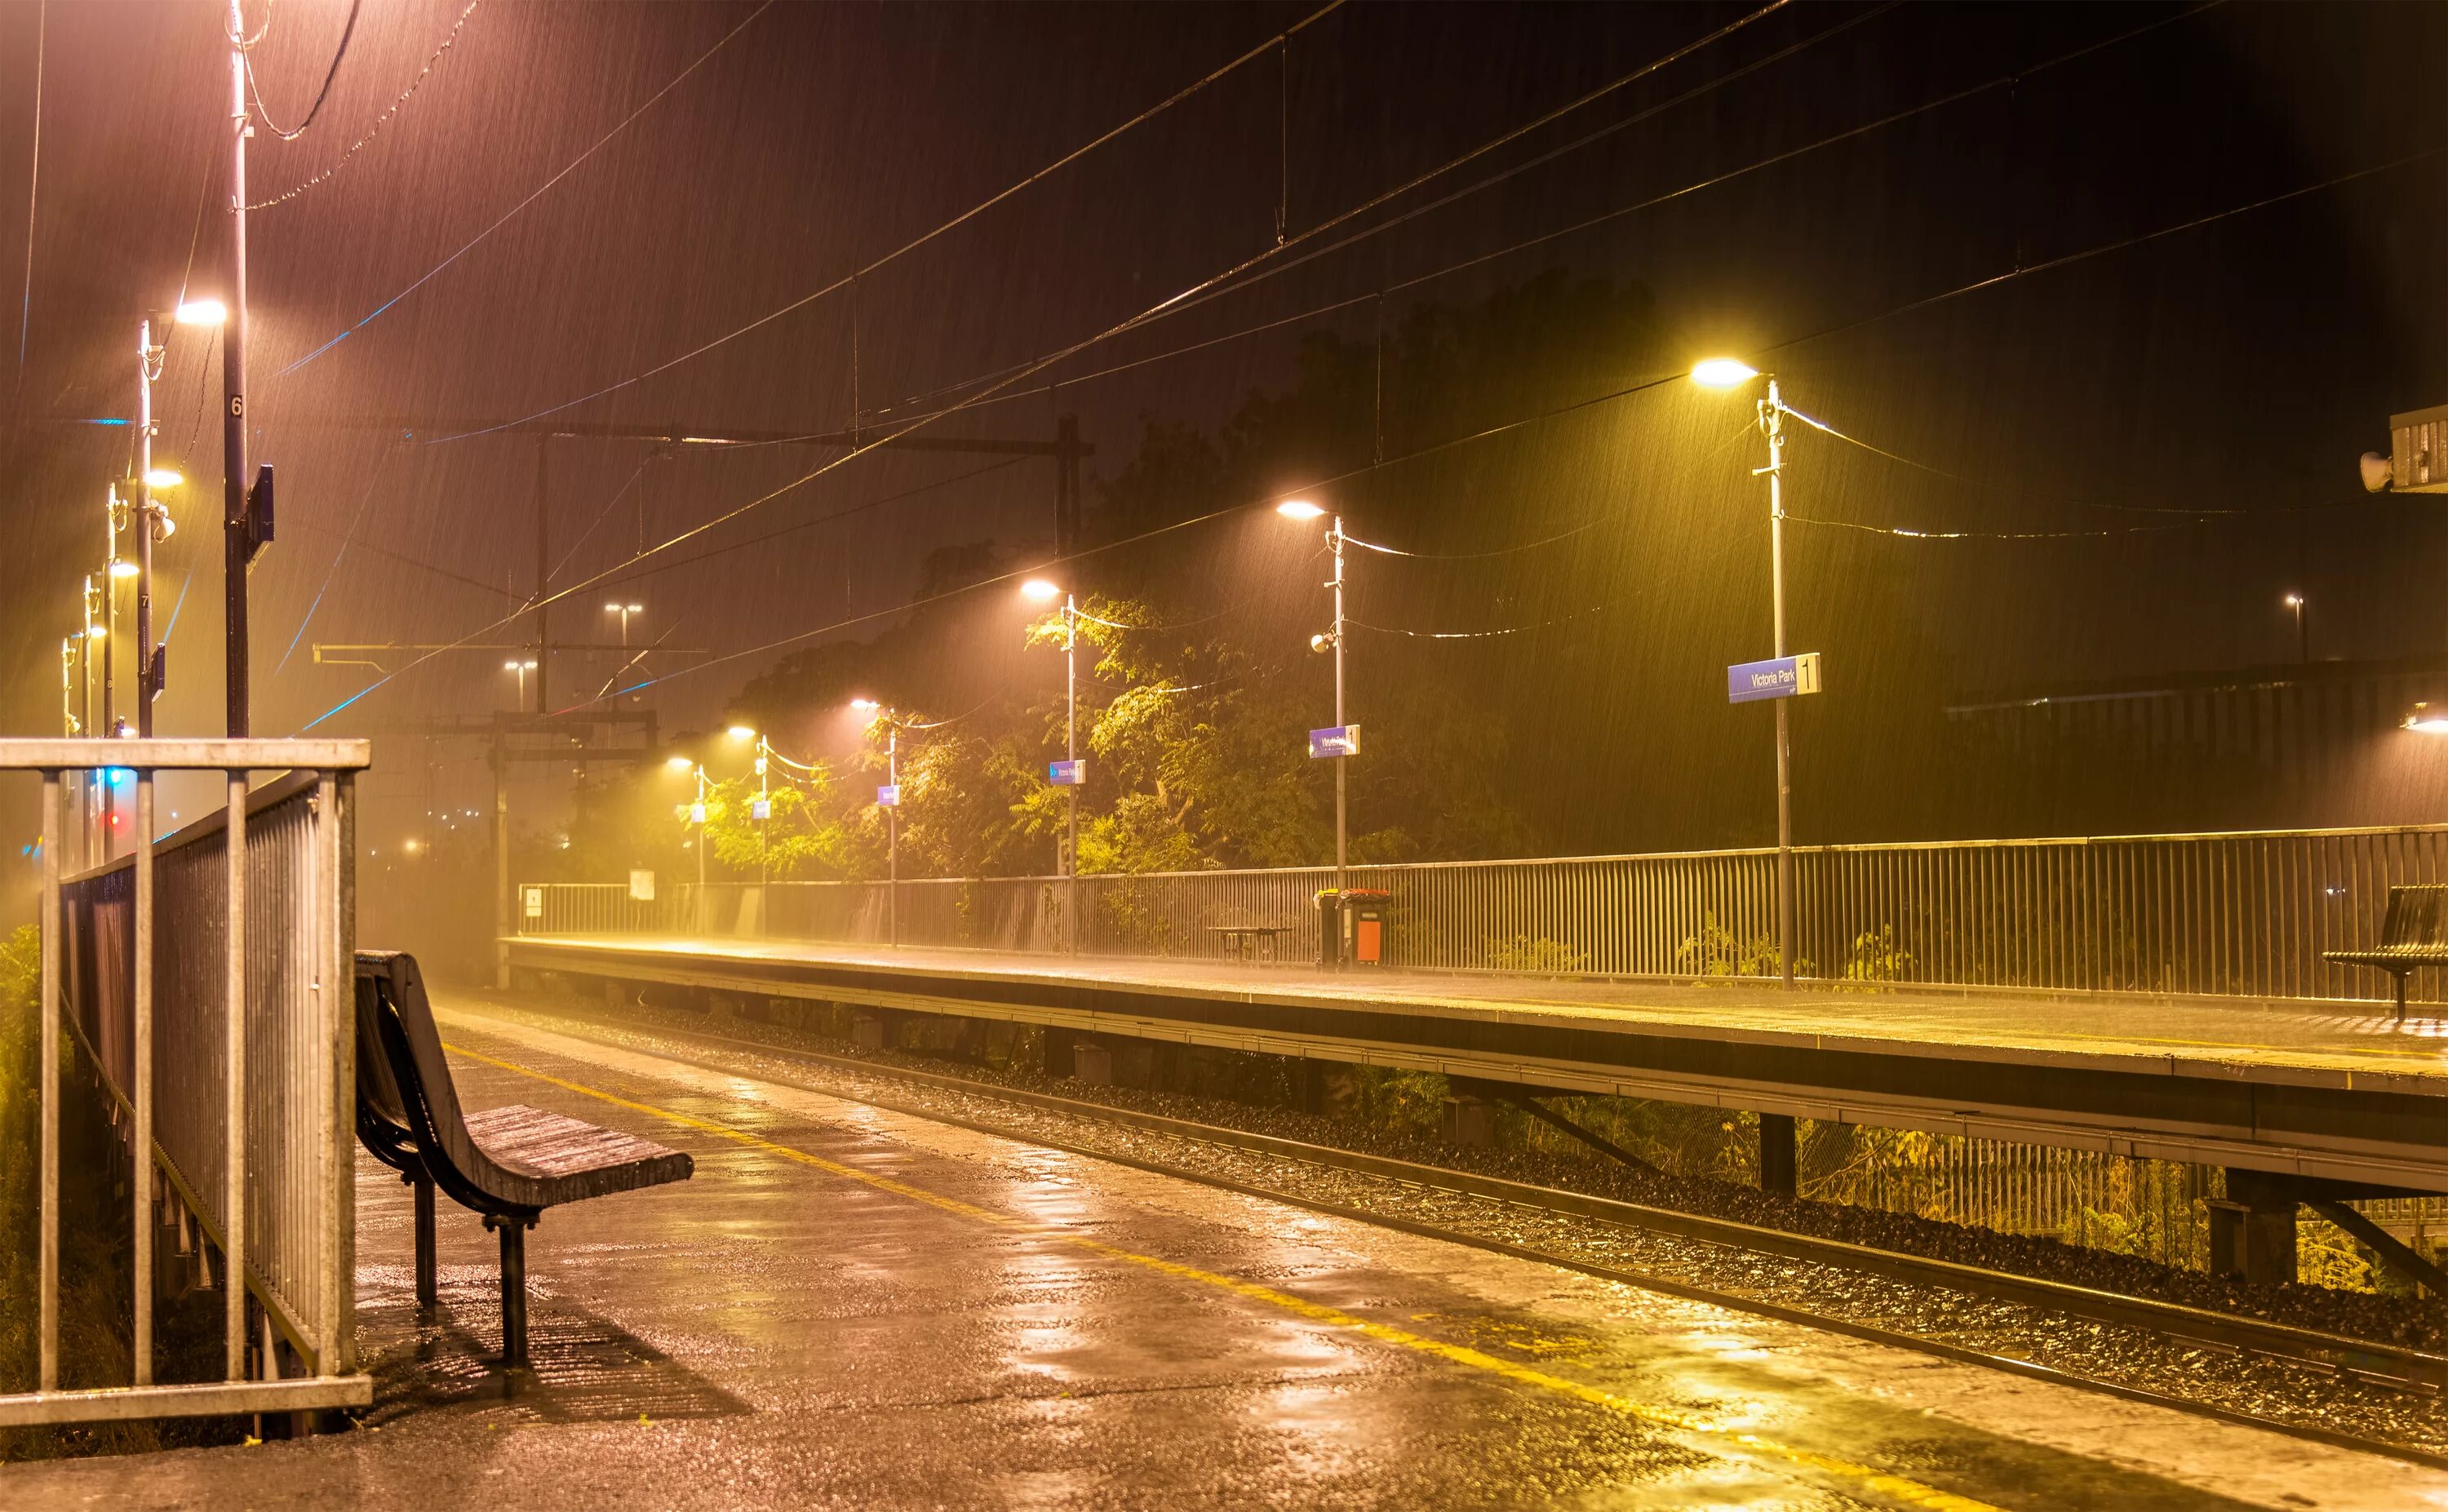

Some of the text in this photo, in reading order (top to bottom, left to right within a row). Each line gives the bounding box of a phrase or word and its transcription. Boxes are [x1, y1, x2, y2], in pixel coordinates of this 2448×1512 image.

[232, 397, 242, 415] 6
[141, 595, 149, 607] 7
[1751, 669, 1795, 687] Victoria Park
[1802, 658, 1810, 689] 1
